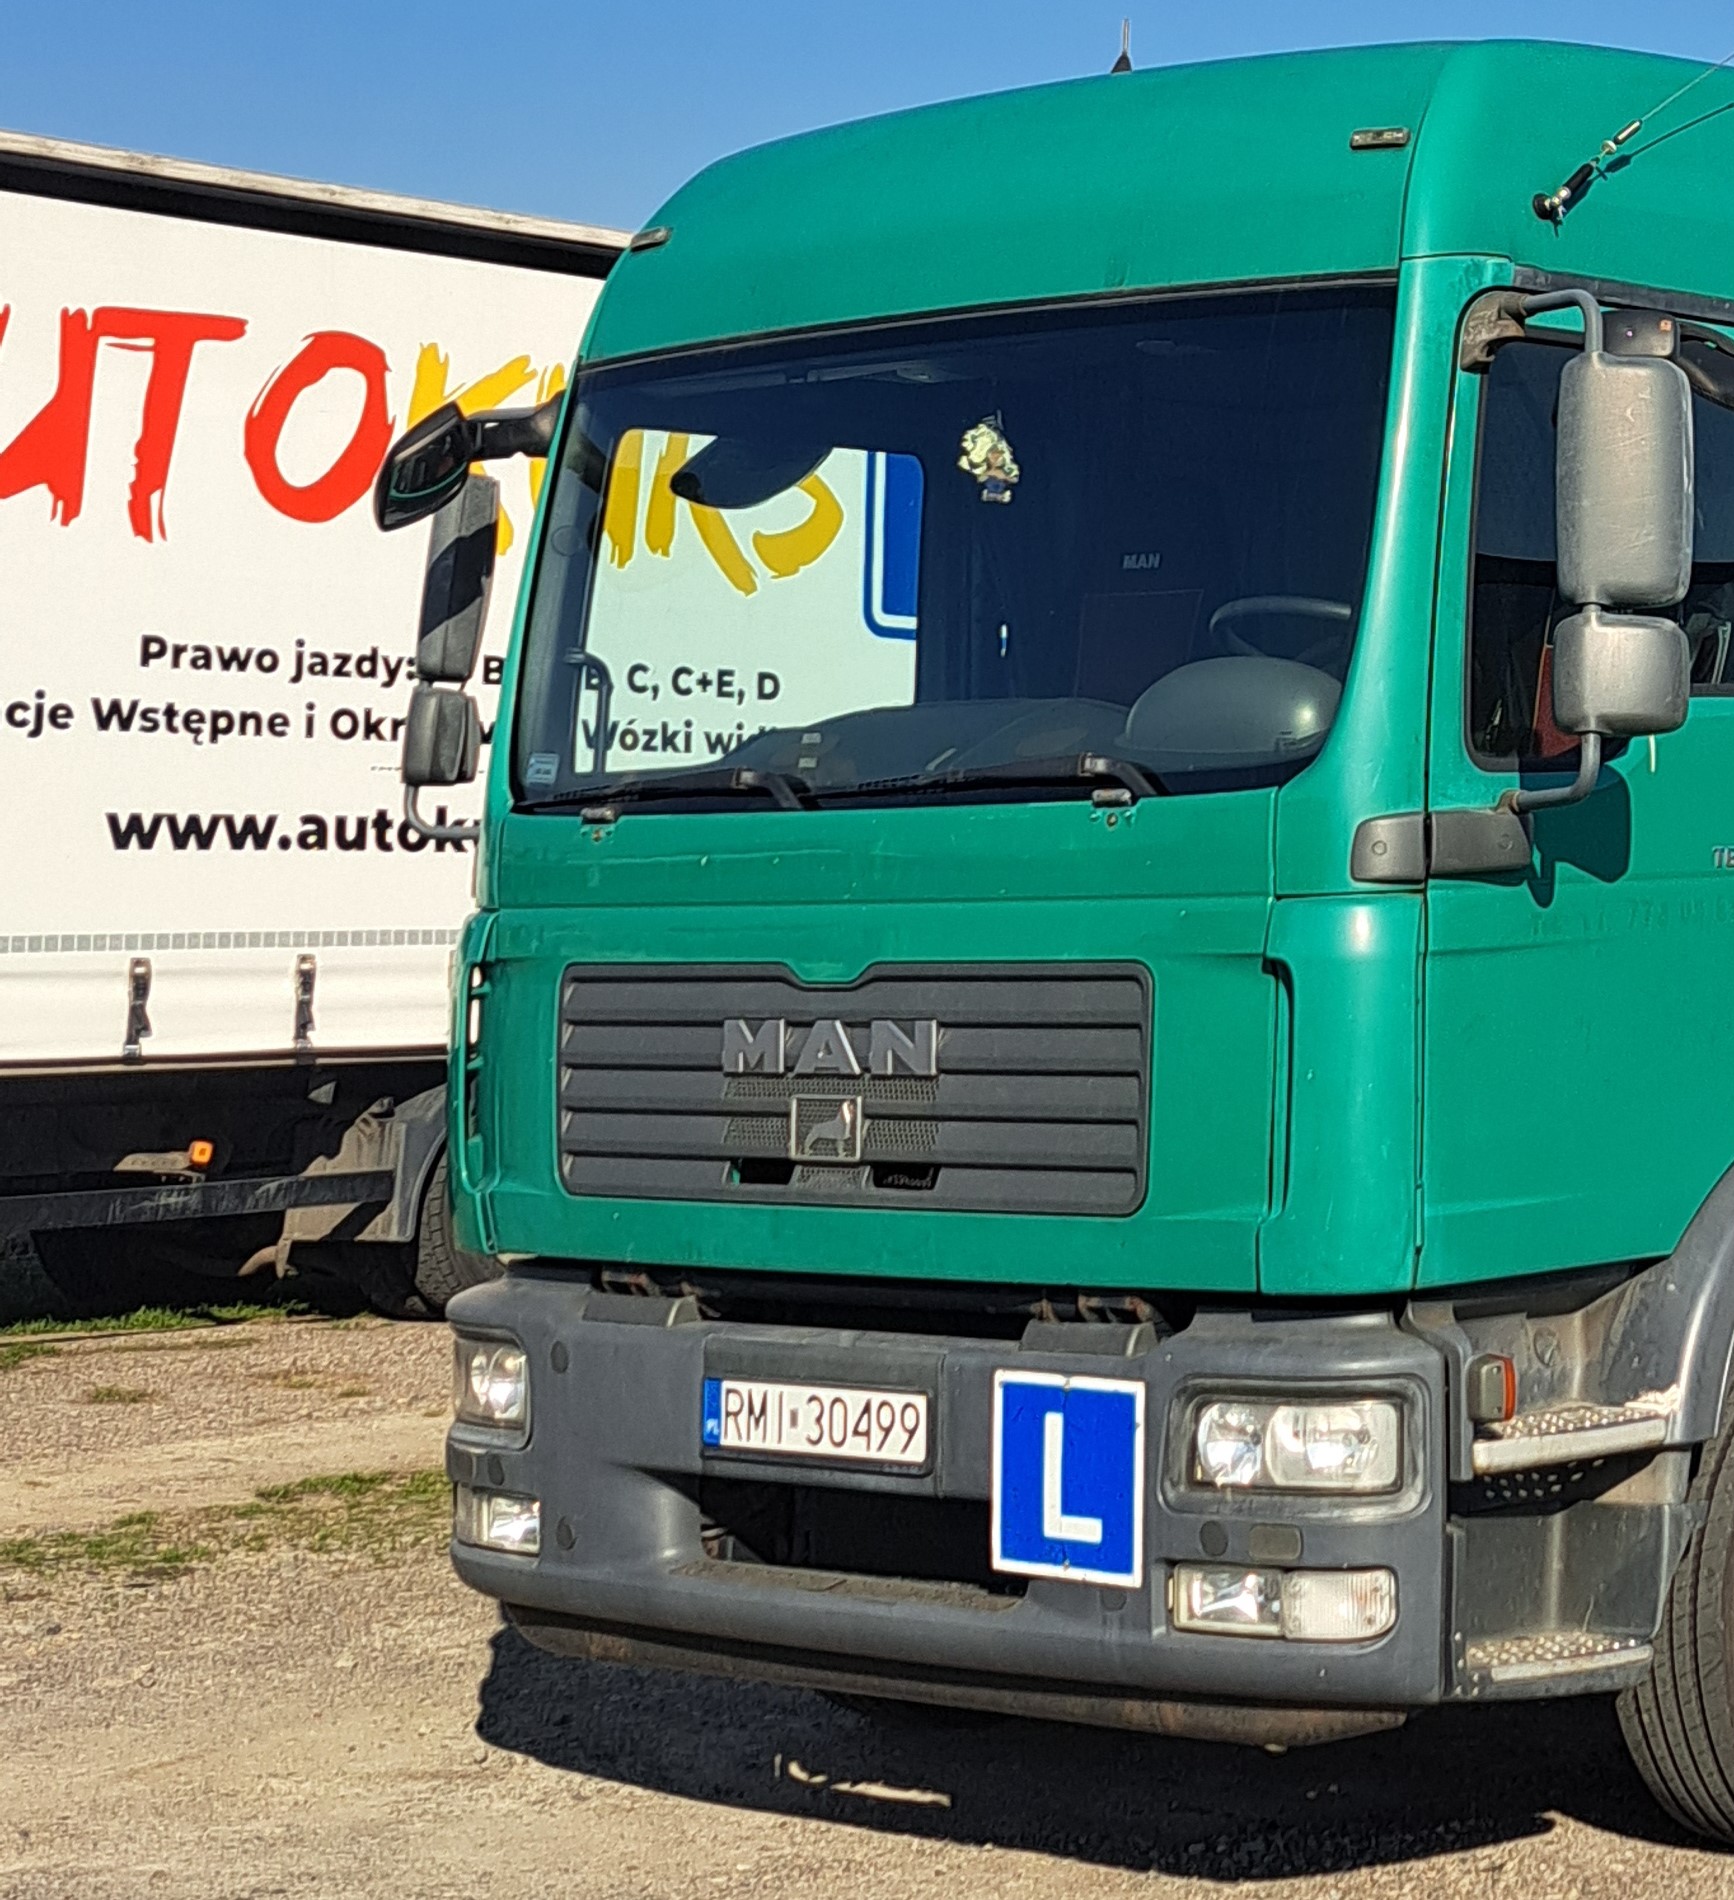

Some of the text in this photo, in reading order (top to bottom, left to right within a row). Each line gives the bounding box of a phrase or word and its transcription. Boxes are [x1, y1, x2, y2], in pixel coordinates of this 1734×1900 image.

[1122, 552, 1161, 569] MAN
[140, 634, 280, 673] Prawo
[289, 638, 416, 688] jazdy:
[626, 663, 659, 701] C,
[671, 666, 746, 706] C+E,
[757, 671, 780, 701] D
[91, 697, 290, 745] Wstępne
[305, 702, 316, 738] i
[582, 718, 693, 753] Wózki
[722, 1018, 939, 1076] MAN
[723, 1388, 921, 1455] RMI 30499
[1044, 1411, 1103, 1545] L
